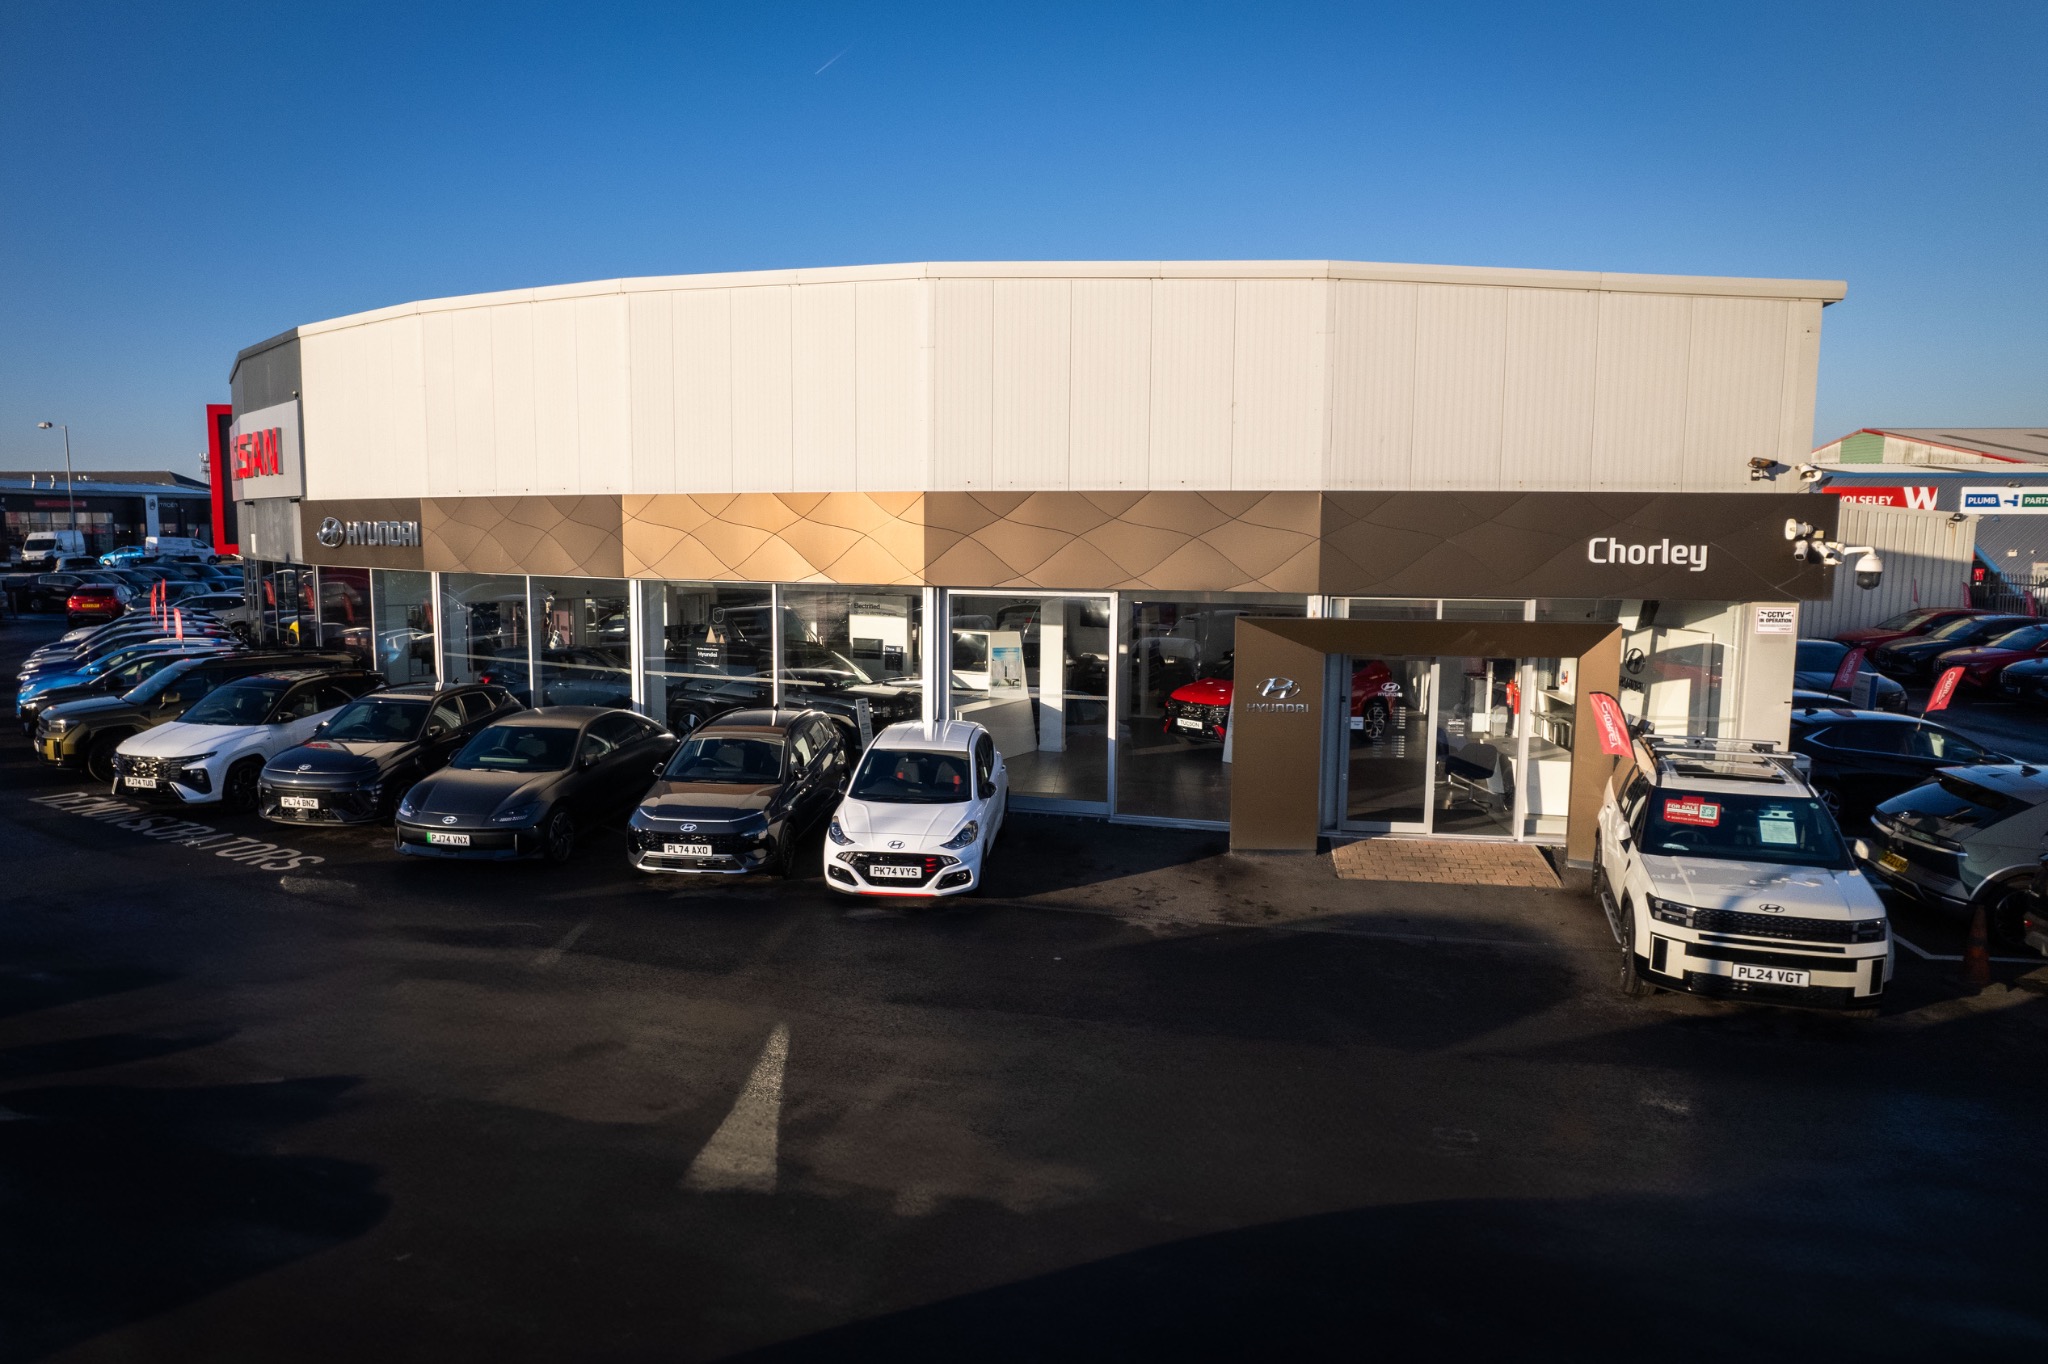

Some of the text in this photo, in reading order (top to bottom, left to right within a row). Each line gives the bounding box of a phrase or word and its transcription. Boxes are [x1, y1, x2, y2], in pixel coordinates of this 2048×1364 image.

[1967, 496, 1997, 505] PLUMB
[346, 521, 421, 547] HYUNDAI
[1588, 537, 1708, 572] Chorley
[1246, 703, 1309, 713] HYUNDAI
[1180, 719, 1200, 728] TUCSON
[1601, 701, 1619, 748] CHORLEY
[284, 798, 315, 808] PL74 BNZ
[28, 791, 326, 871] DEMONSTRATORS
[431, 833, 468, 845] PJ74 VNX
[667, 844, 689, 854] PL74
[873, 866, 918, 877] PK74 VYS
[1738, 966, 1804, 984] PL24 VGT
